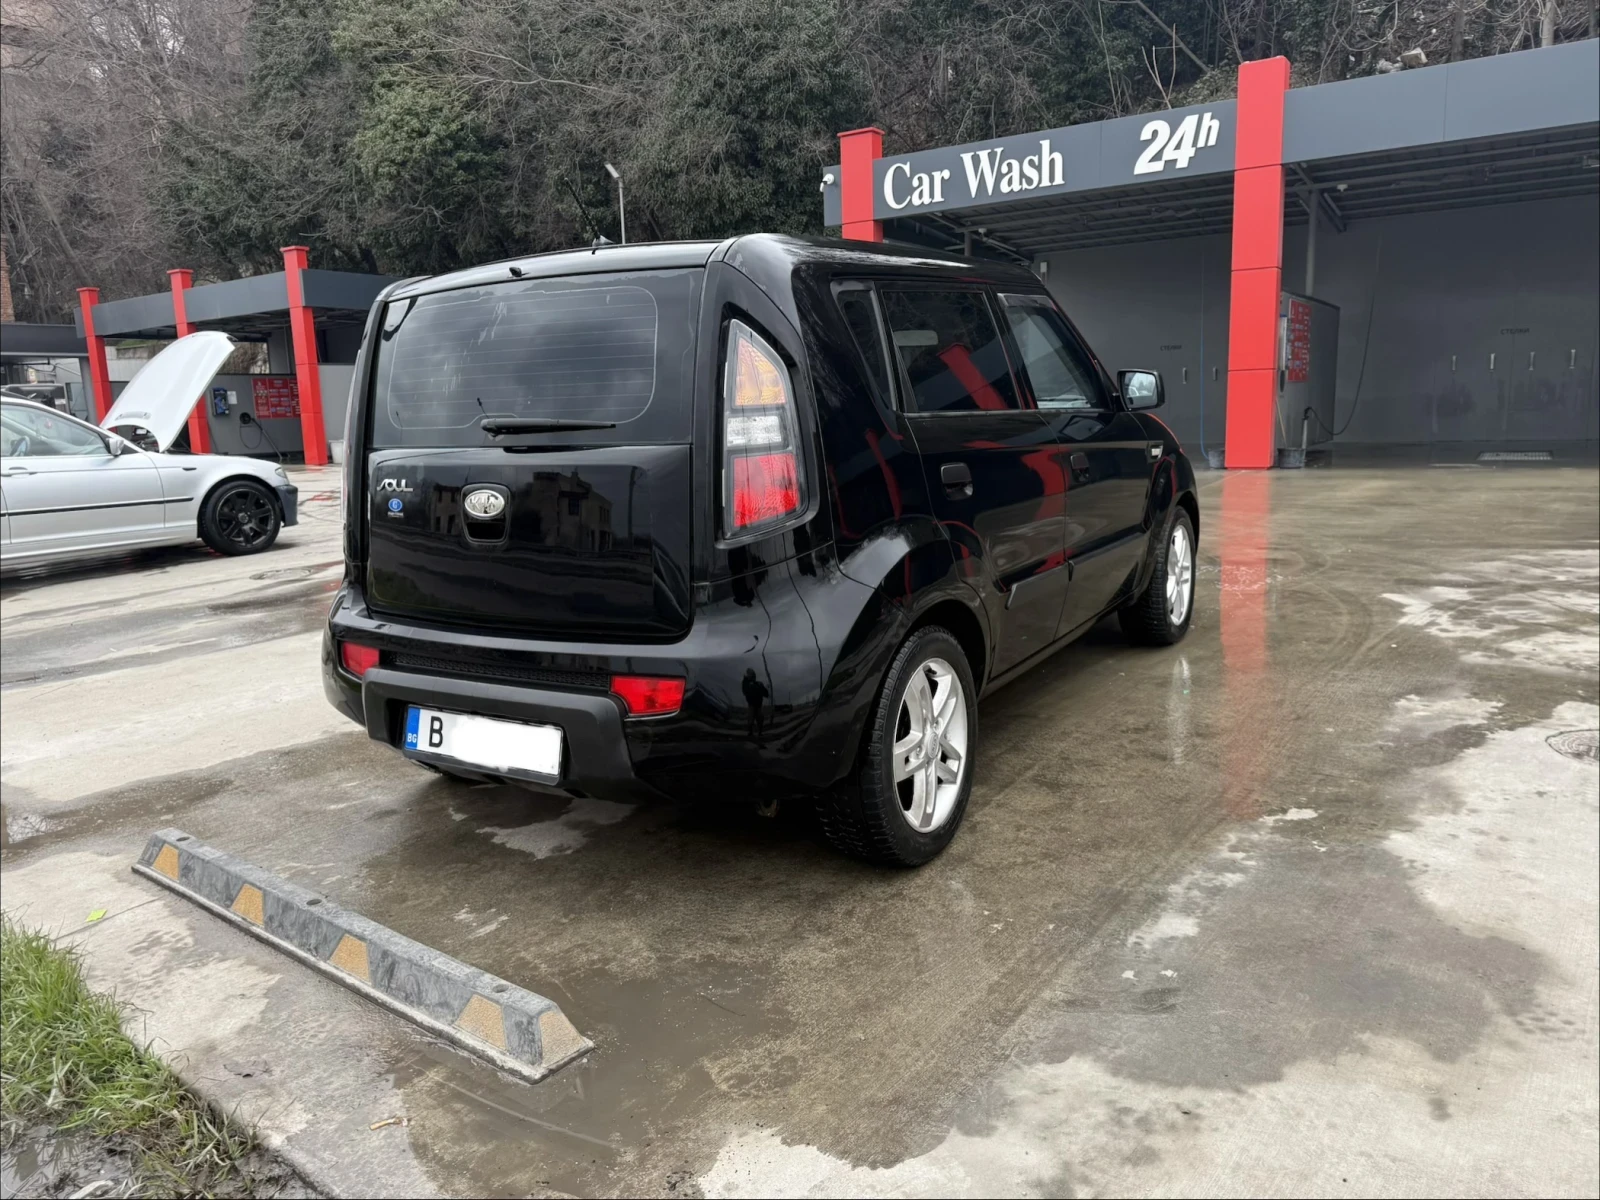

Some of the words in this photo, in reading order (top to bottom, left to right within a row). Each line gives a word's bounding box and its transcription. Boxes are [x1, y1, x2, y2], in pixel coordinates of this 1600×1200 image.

[1133, 111, 1220, 175] 24h
[883, 161, 950, 210] Car
[960, 139, 1065, 199] Wash
[376, 478, 414, 492] SOUL
[407, 732, 418, 744] BG
[428, 715, 444, 748] B
